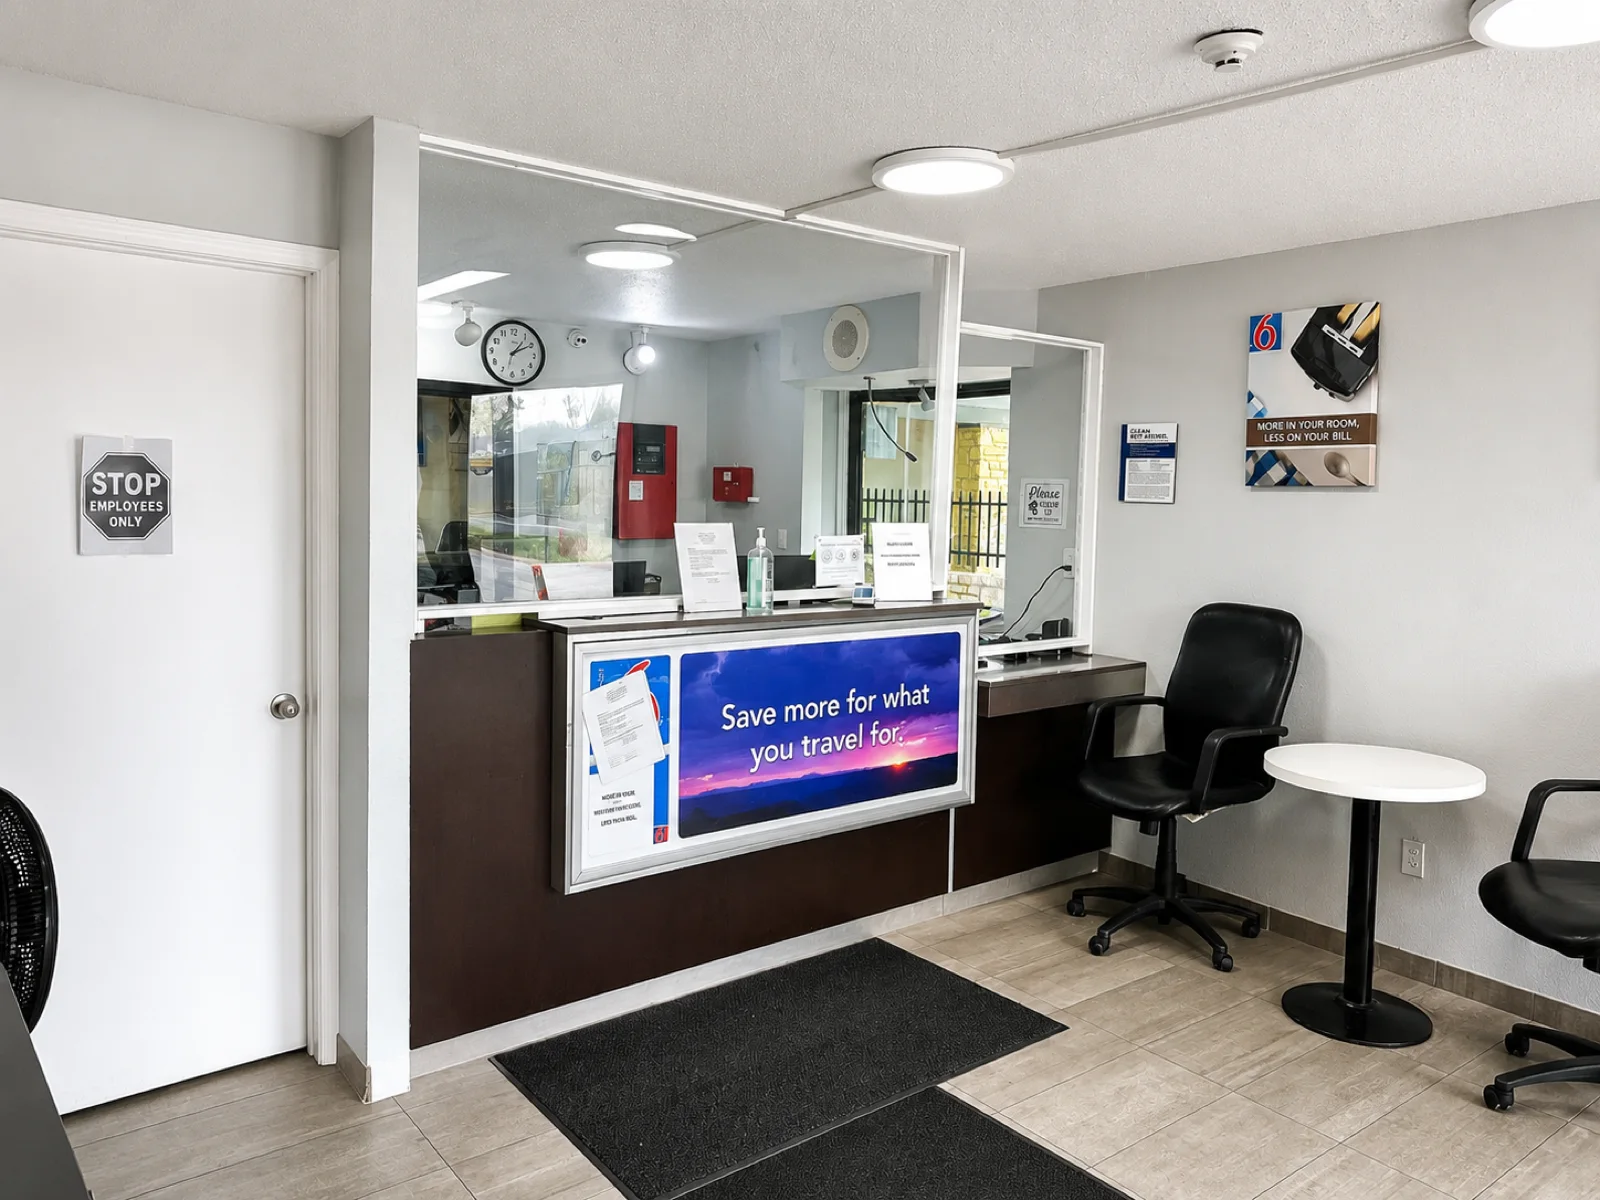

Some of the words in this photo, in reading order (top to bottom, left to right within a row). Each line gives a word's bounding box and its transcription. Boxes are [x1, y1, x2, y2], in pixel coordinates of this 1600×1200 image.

[1253, 313, 1277, 351] 6
[1257, 421, 1284, 431] MORE
[1286, 421, 1297, 431] IN
[1299, 420, 1325, 430] YOUR
[1326, 419, 1360, 429] ROOM,
[1264, 433, 1285, 443] LESS
[1287, 432, 1301, 442] ON
[1303, 432, 1329, 442] YOUR
[1332, 431, 1352, 441] BILL
[91, 471, 161, 496] STOP
[90, 500, 164, 512] EMPLOYEES
[109, 515, 143, 527] ONLY
[721, 703, 777, 731] Save
[784, 699, 840, 723] more
[845, 687, 877, 714] for
[882, 683, 930, 709] what
[749, 741, 793, 773] you
[801, 722, 864, 757] travel
